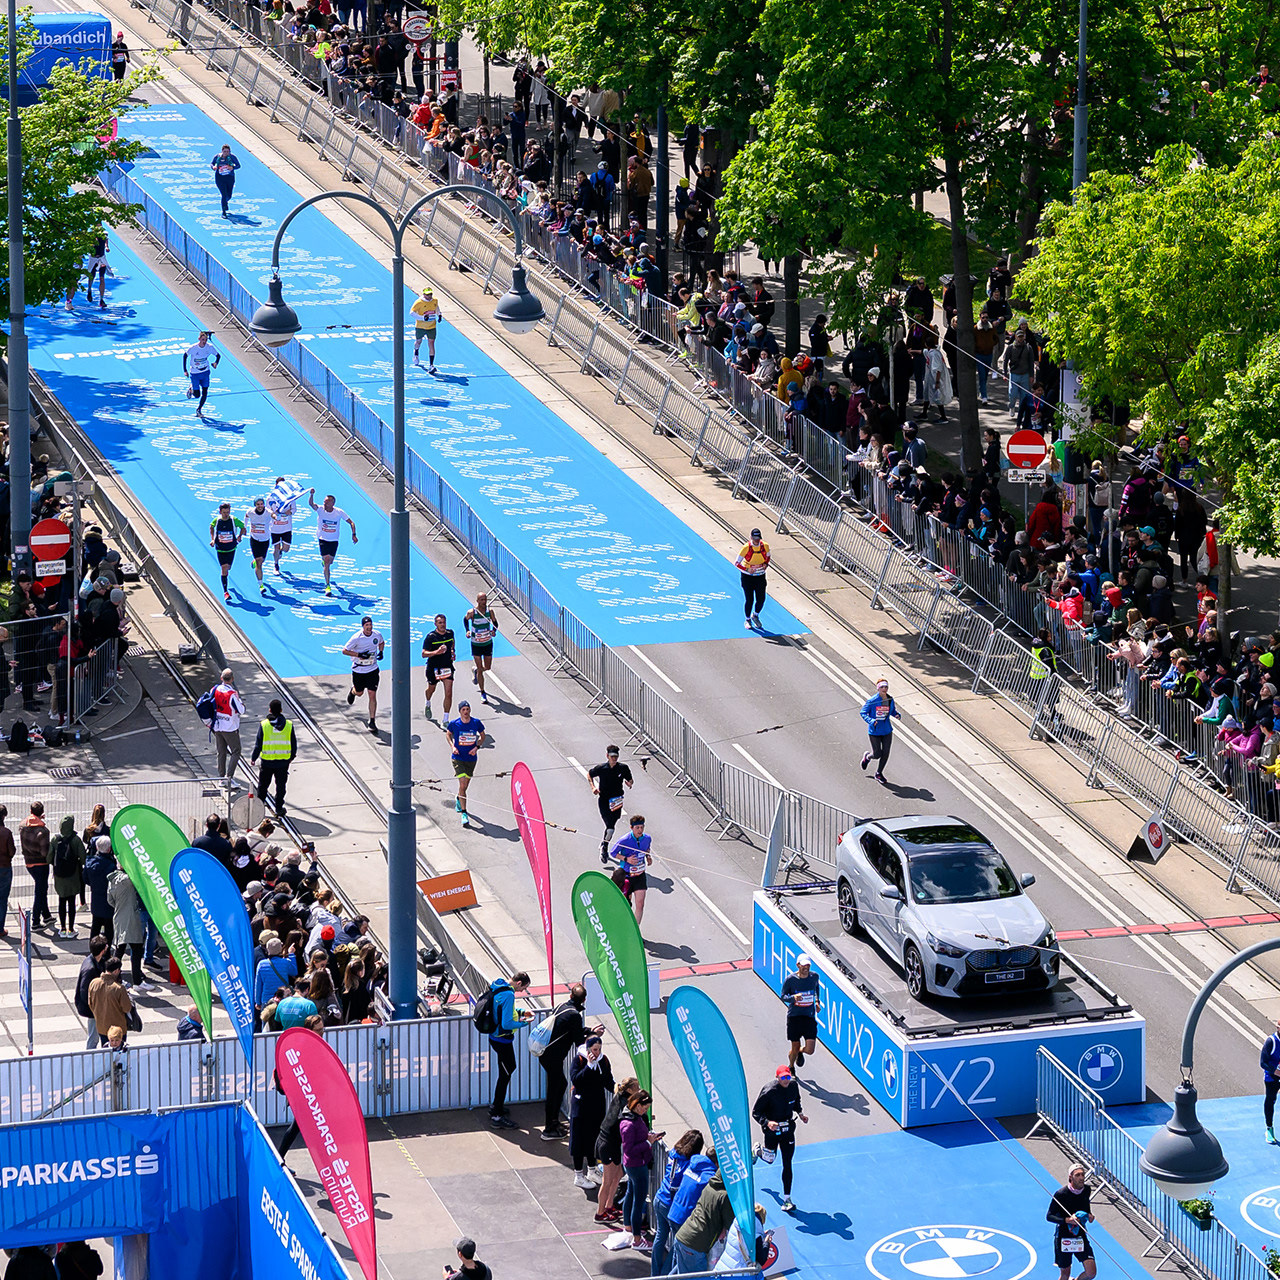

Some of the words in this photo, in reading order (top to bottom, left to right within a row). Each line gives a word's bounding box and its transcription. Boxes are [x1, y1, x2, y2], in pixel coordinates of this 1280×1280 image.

[27, 30, 105, 46] ubandich
[429, 890, 446, 899] WIEN
[446, 884, 472, 896] ENERGIE
[846, 1004, 875, 1080] iX2
[909, 1065, 918, 1089] NEW
[921, 1056, 997, 1110] iX2
[909, 1091, 918, 1112] THE
[261, 1186, 282, 1237] ERSTE
[878, 1228, 995, 1255] BMW
